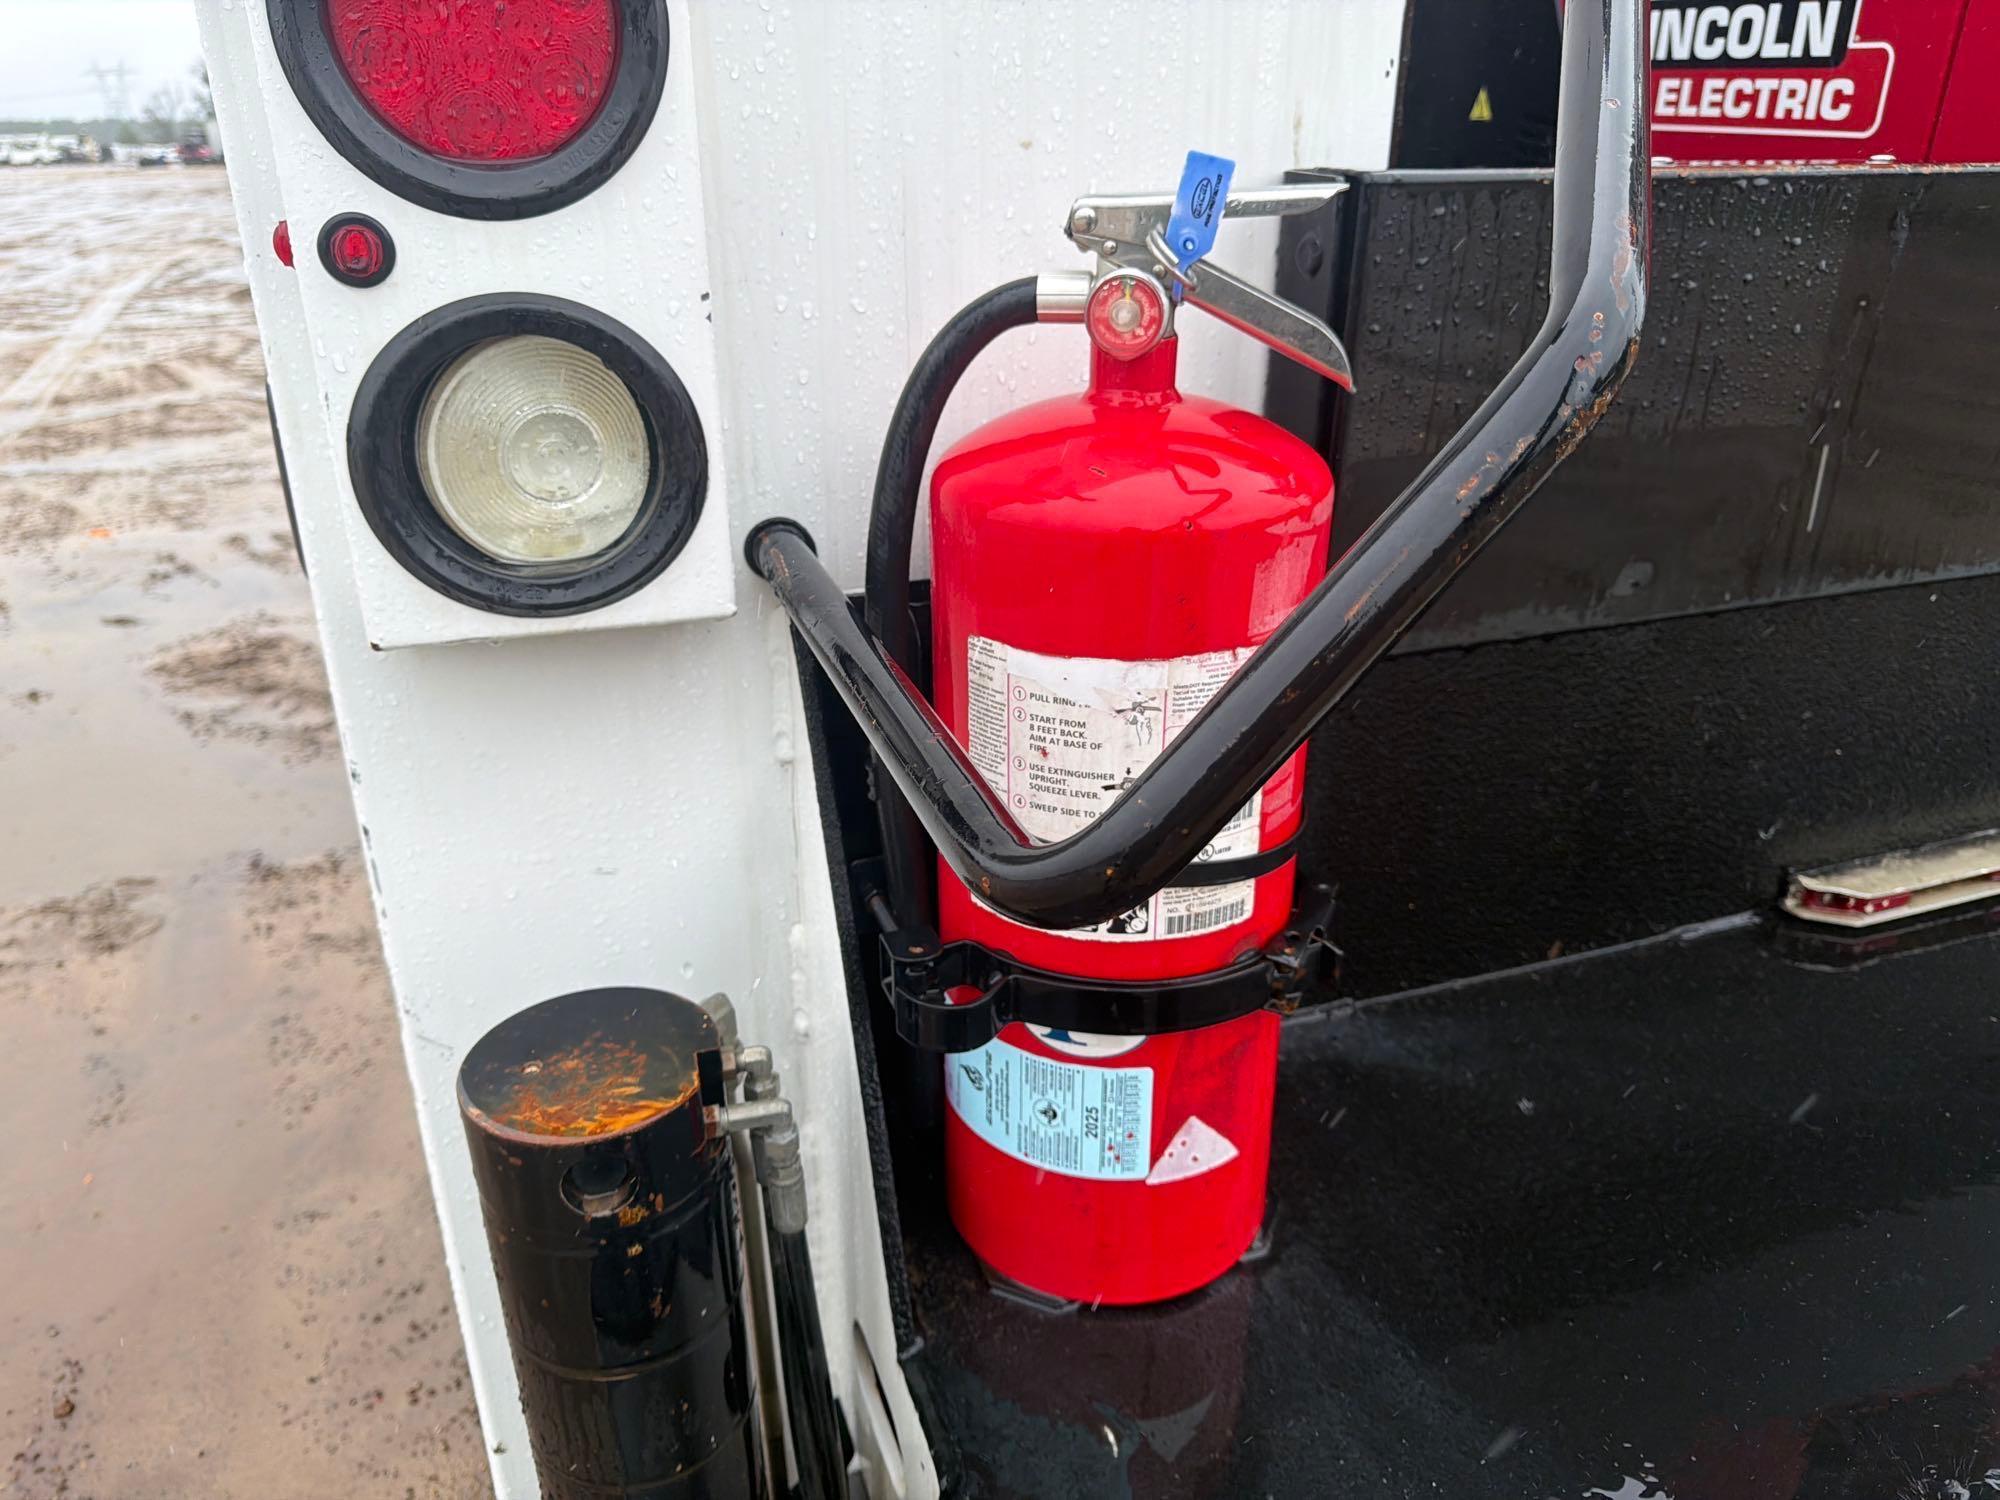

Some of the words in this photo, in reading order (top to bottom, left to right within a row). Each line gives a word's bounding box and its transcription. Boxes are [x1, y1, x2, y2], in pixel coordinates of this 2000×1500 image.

[1651, 1, 1842, 60] INCOLN
[1654, 78, 1855, 121] ELECTRIC
[1029, 692, 1050, 704] PULL
[1053, 696, 1076, 707] RING
[1029, 713, 1056, 726] START
[1059, 718, 1086, 729] FROM
[1037, 725, 1057, 735] FEET
[1060, 729, 1088, 739] BACK.
[1029, 734, 1047, 743] AIM
[1049, 737, 1060, 746] AT
[1063, 739, 1087, 749] BASE
[1090, 742, 1103, 750] OF
[1029, 762, 1045, 773] USE
[1048, 766, 1115, 781] EXTINGUISHER
[1029, 772, 1069, 787] UPRIGHT.
[1029, 782, 1067, 796] SQUEEZE
[1070, 789, 1102, 800] LEVER.
[1029, 801, 1058, 814] SWEEP
[1060, 807, 1080, 818] SIDE
[1083, 810, 1096, 819] TO
[1085, 1106, 1099, 1140] 2025
